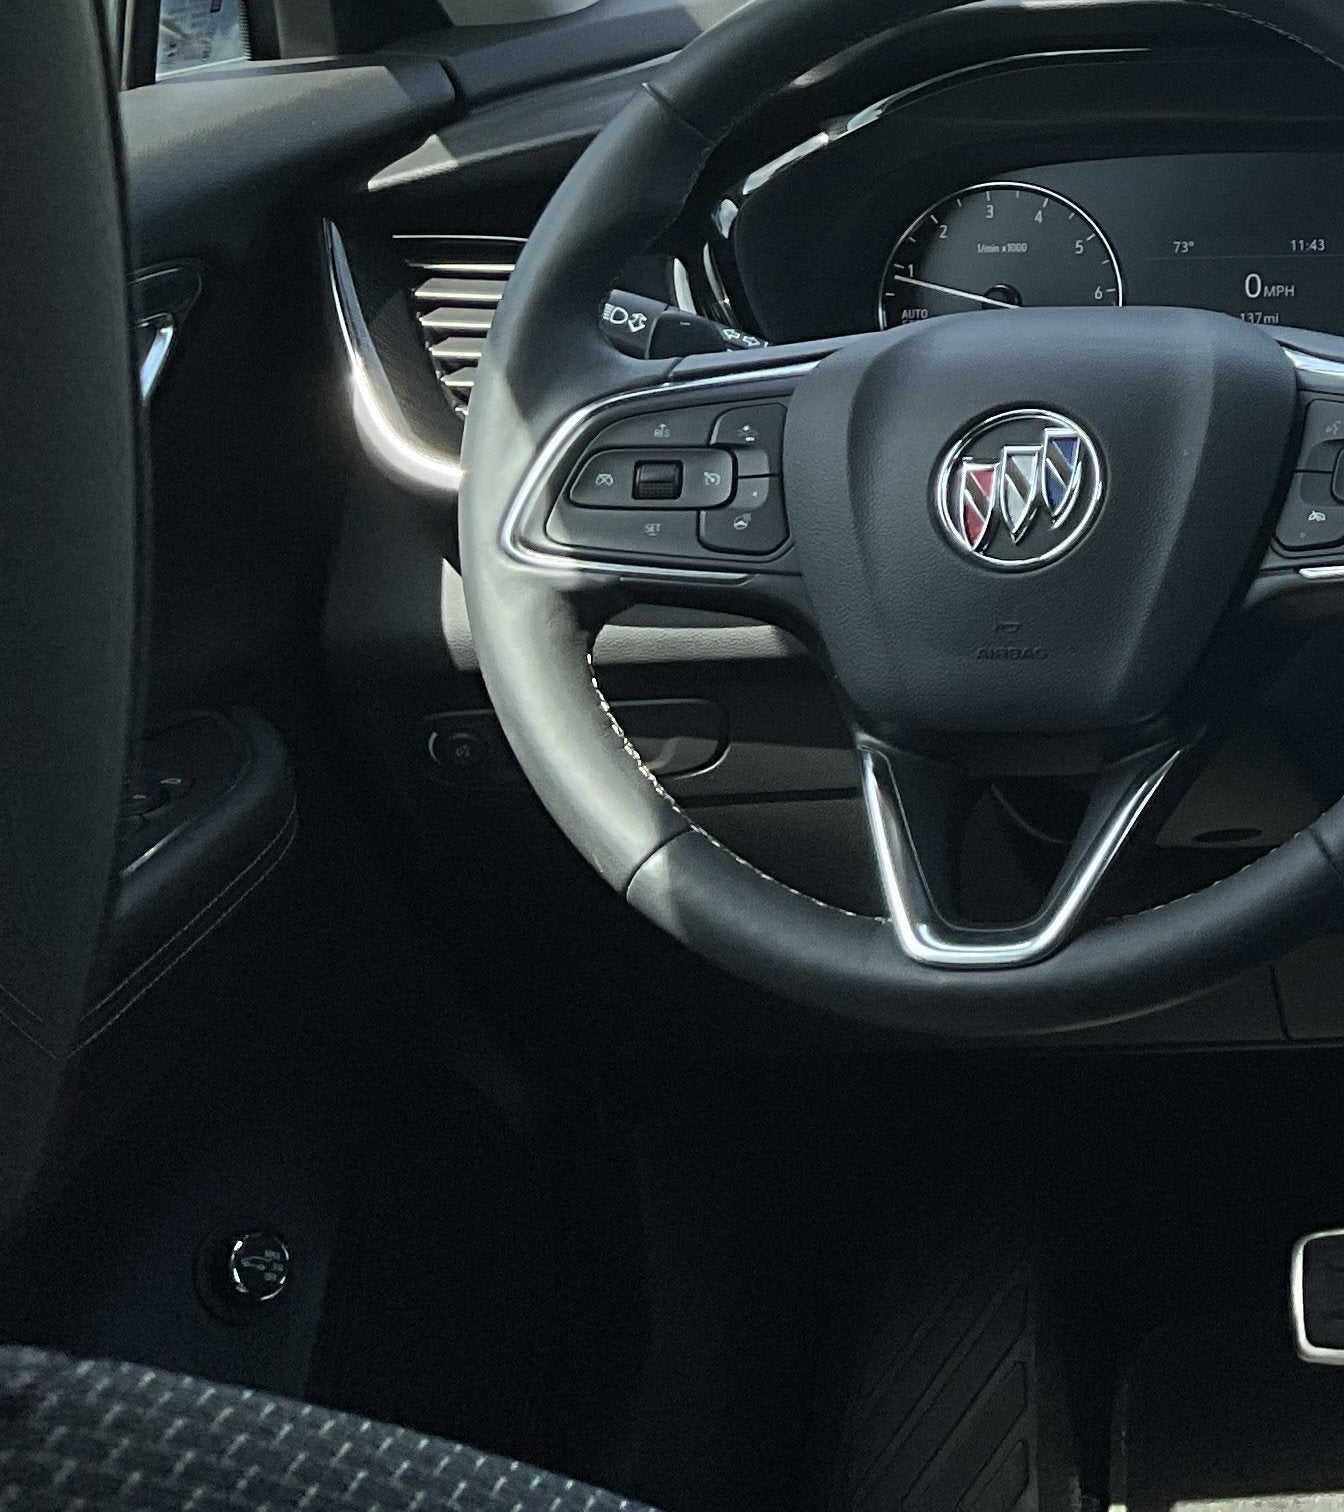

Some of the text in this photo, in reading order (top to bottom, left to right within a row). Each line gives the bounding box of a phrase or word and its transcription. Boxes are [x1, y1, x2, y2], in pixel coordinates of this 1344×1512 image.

[986, 205, 995, 219] 3
[1034, 210, 1043, 224] 4
[939, 224, 948, 239] 2
[1075, 240, 1084, 254] 5
[1172, 241, 1195, 253] 73°
[1290, 239, 1325, 251] 11:43
[1245, 273, 1262, 298] 0
[1263, 286, 1295, 298] MPH
[1094, 286, 1103, 299] 6
[901, 309, 928, 319] AUTO
